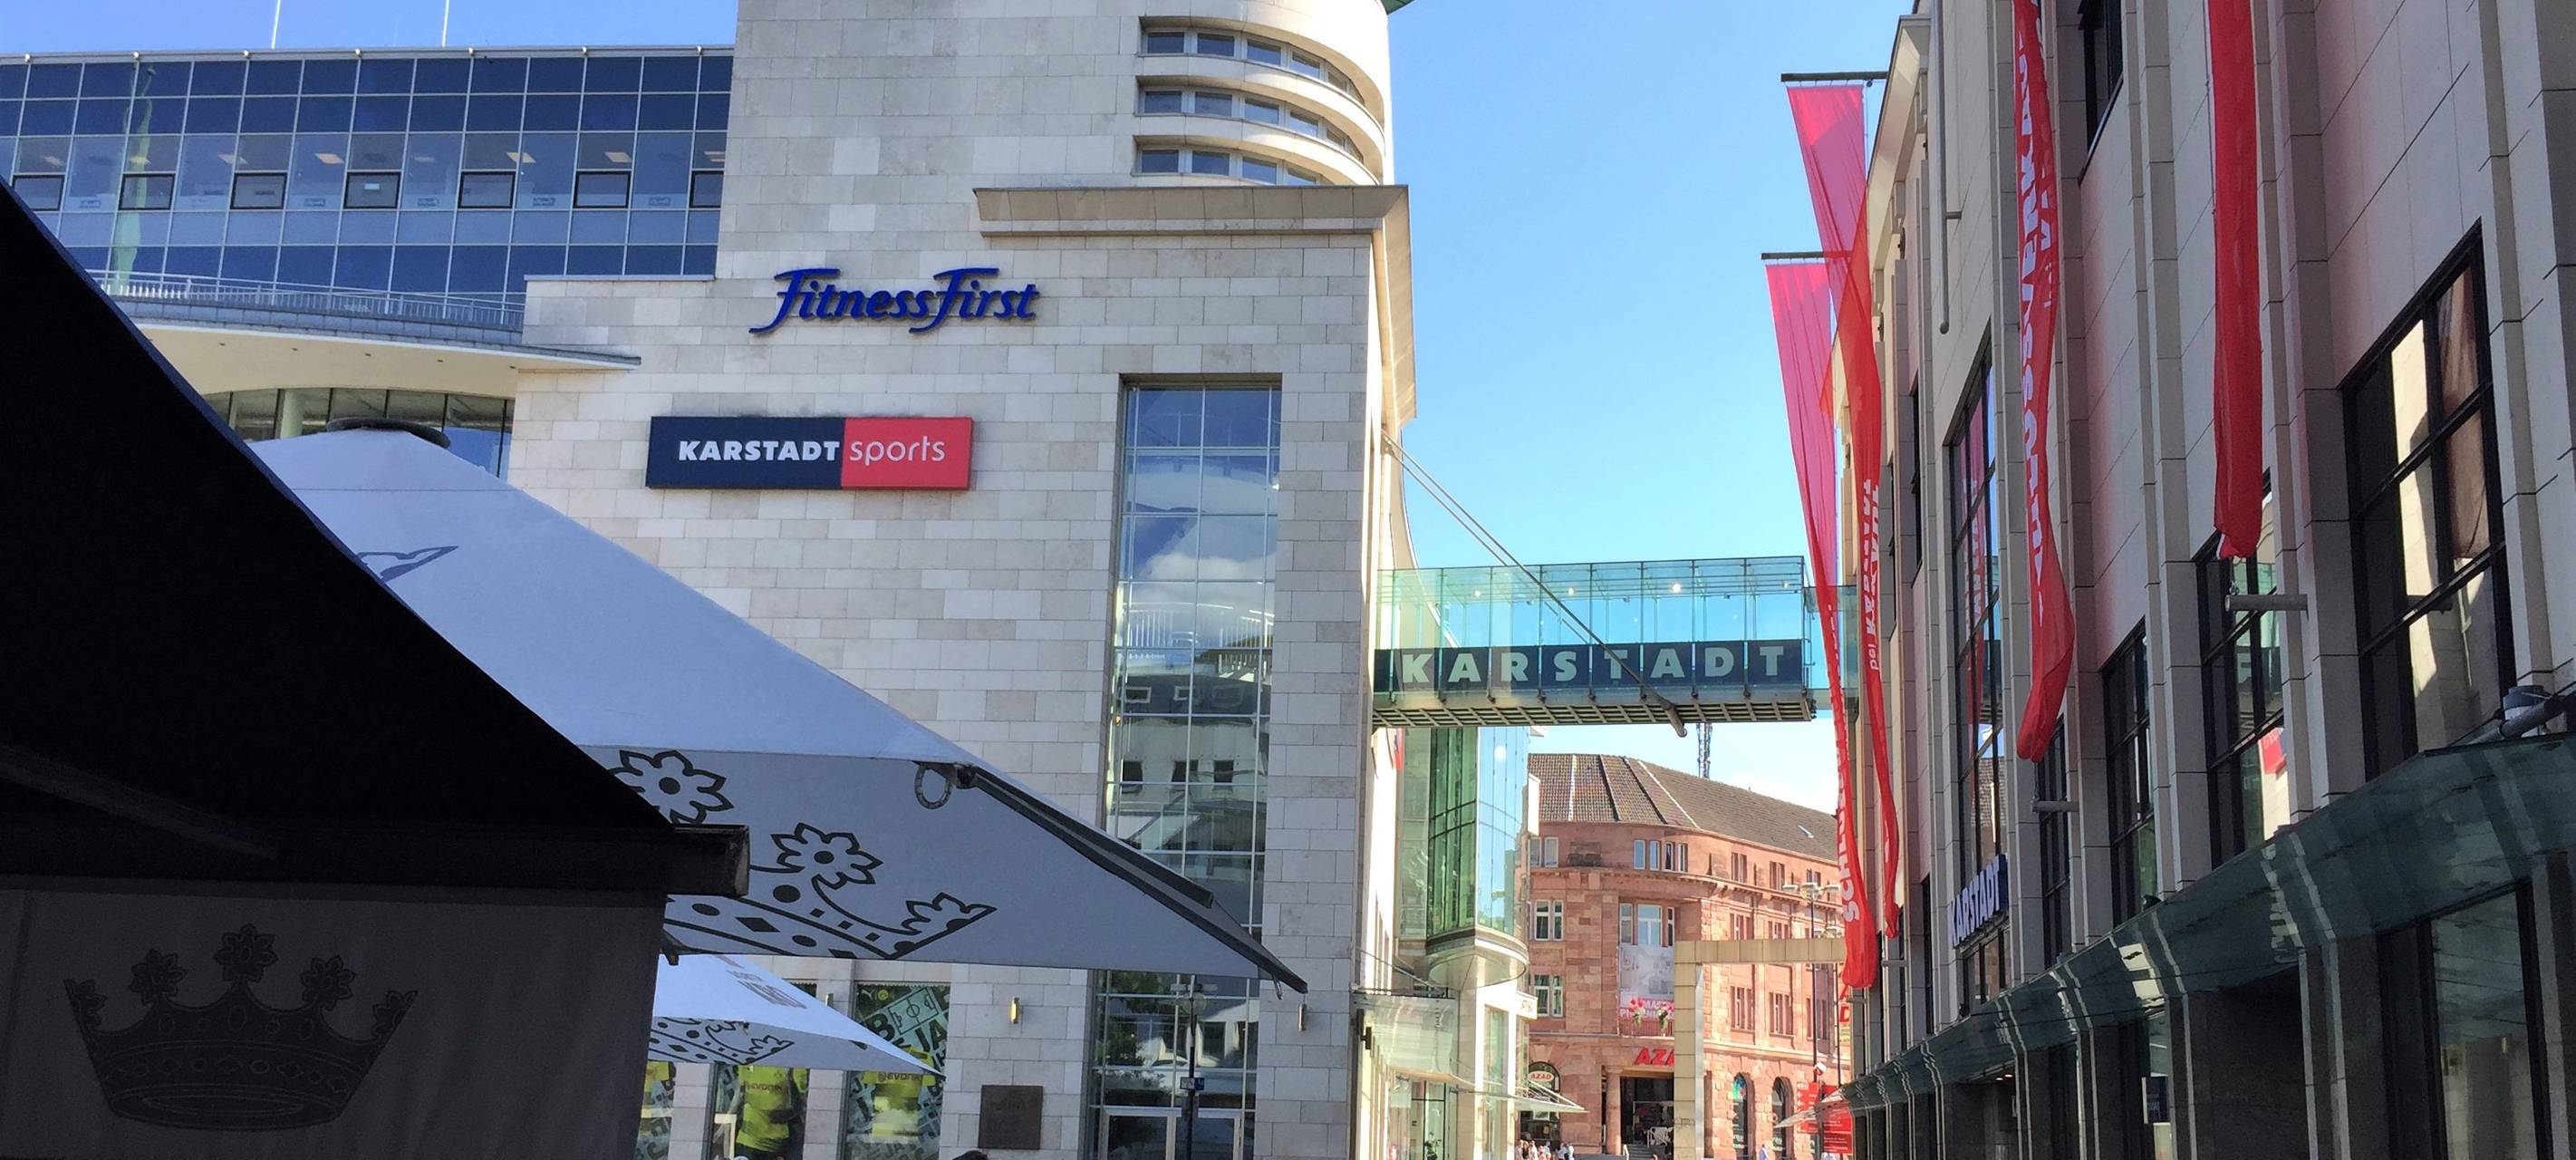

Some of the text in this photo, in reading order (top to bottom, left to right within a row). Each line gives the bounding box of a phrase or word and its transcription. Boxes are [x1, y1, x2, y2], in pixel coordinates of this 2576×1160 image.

[679, 435, 947, 466] KARSTADT sports
[1402, 644, 1785, 683] KARSTADT
[1949, 855, 2000, 947] KARSTADT
